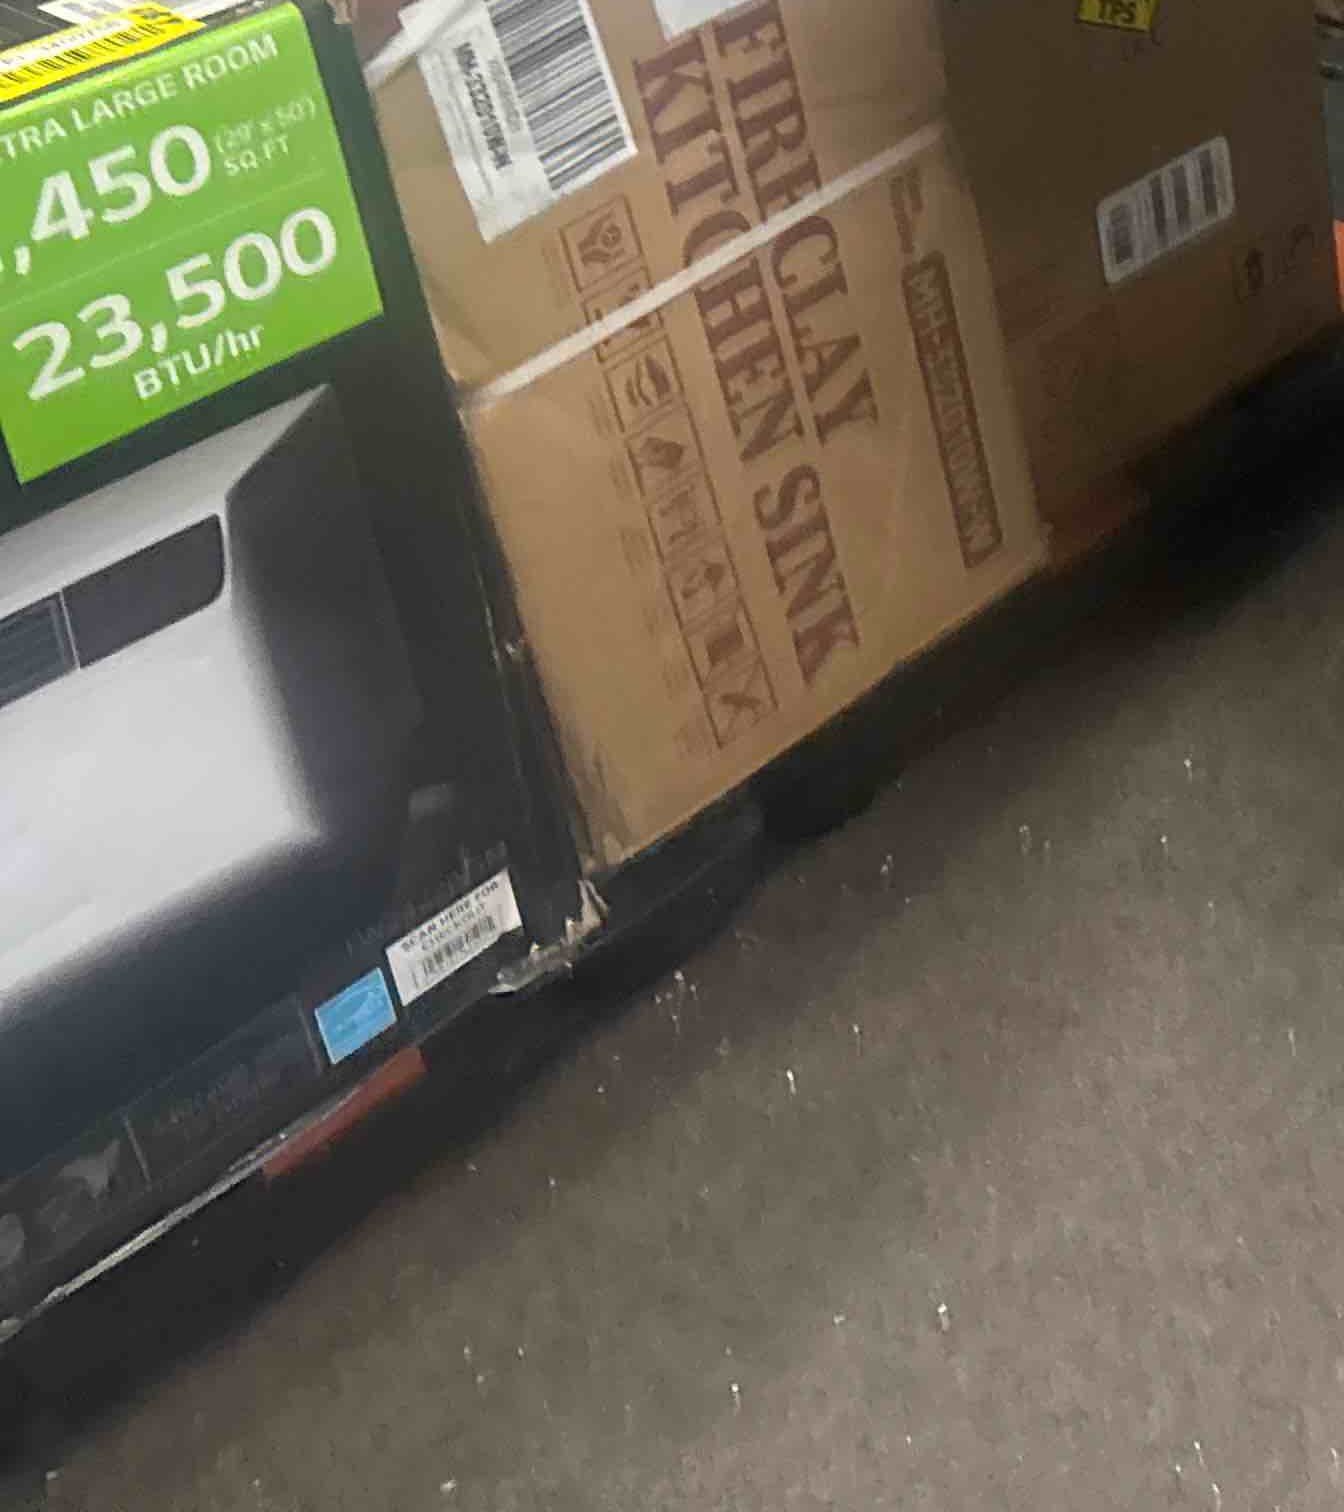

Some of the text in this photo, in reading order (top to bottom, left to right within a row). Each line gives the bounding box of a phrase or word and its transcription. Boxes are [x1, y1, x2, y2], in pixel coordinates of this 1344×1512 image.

[71, 73, 178, 132] LARGE
[182, 33, 279, 89] ROOM
[0, 124, 210, 275] ,450
[12, 206, 338, 402] 23,500
[133, 322, 264, 402] BTU/hr
[633, 40, 804, 465] KITCHEN
[752, 463, 861, 685] SINK
[401, 923, 438, 953] SCAN
[475, 879, 499, 902] FOR
